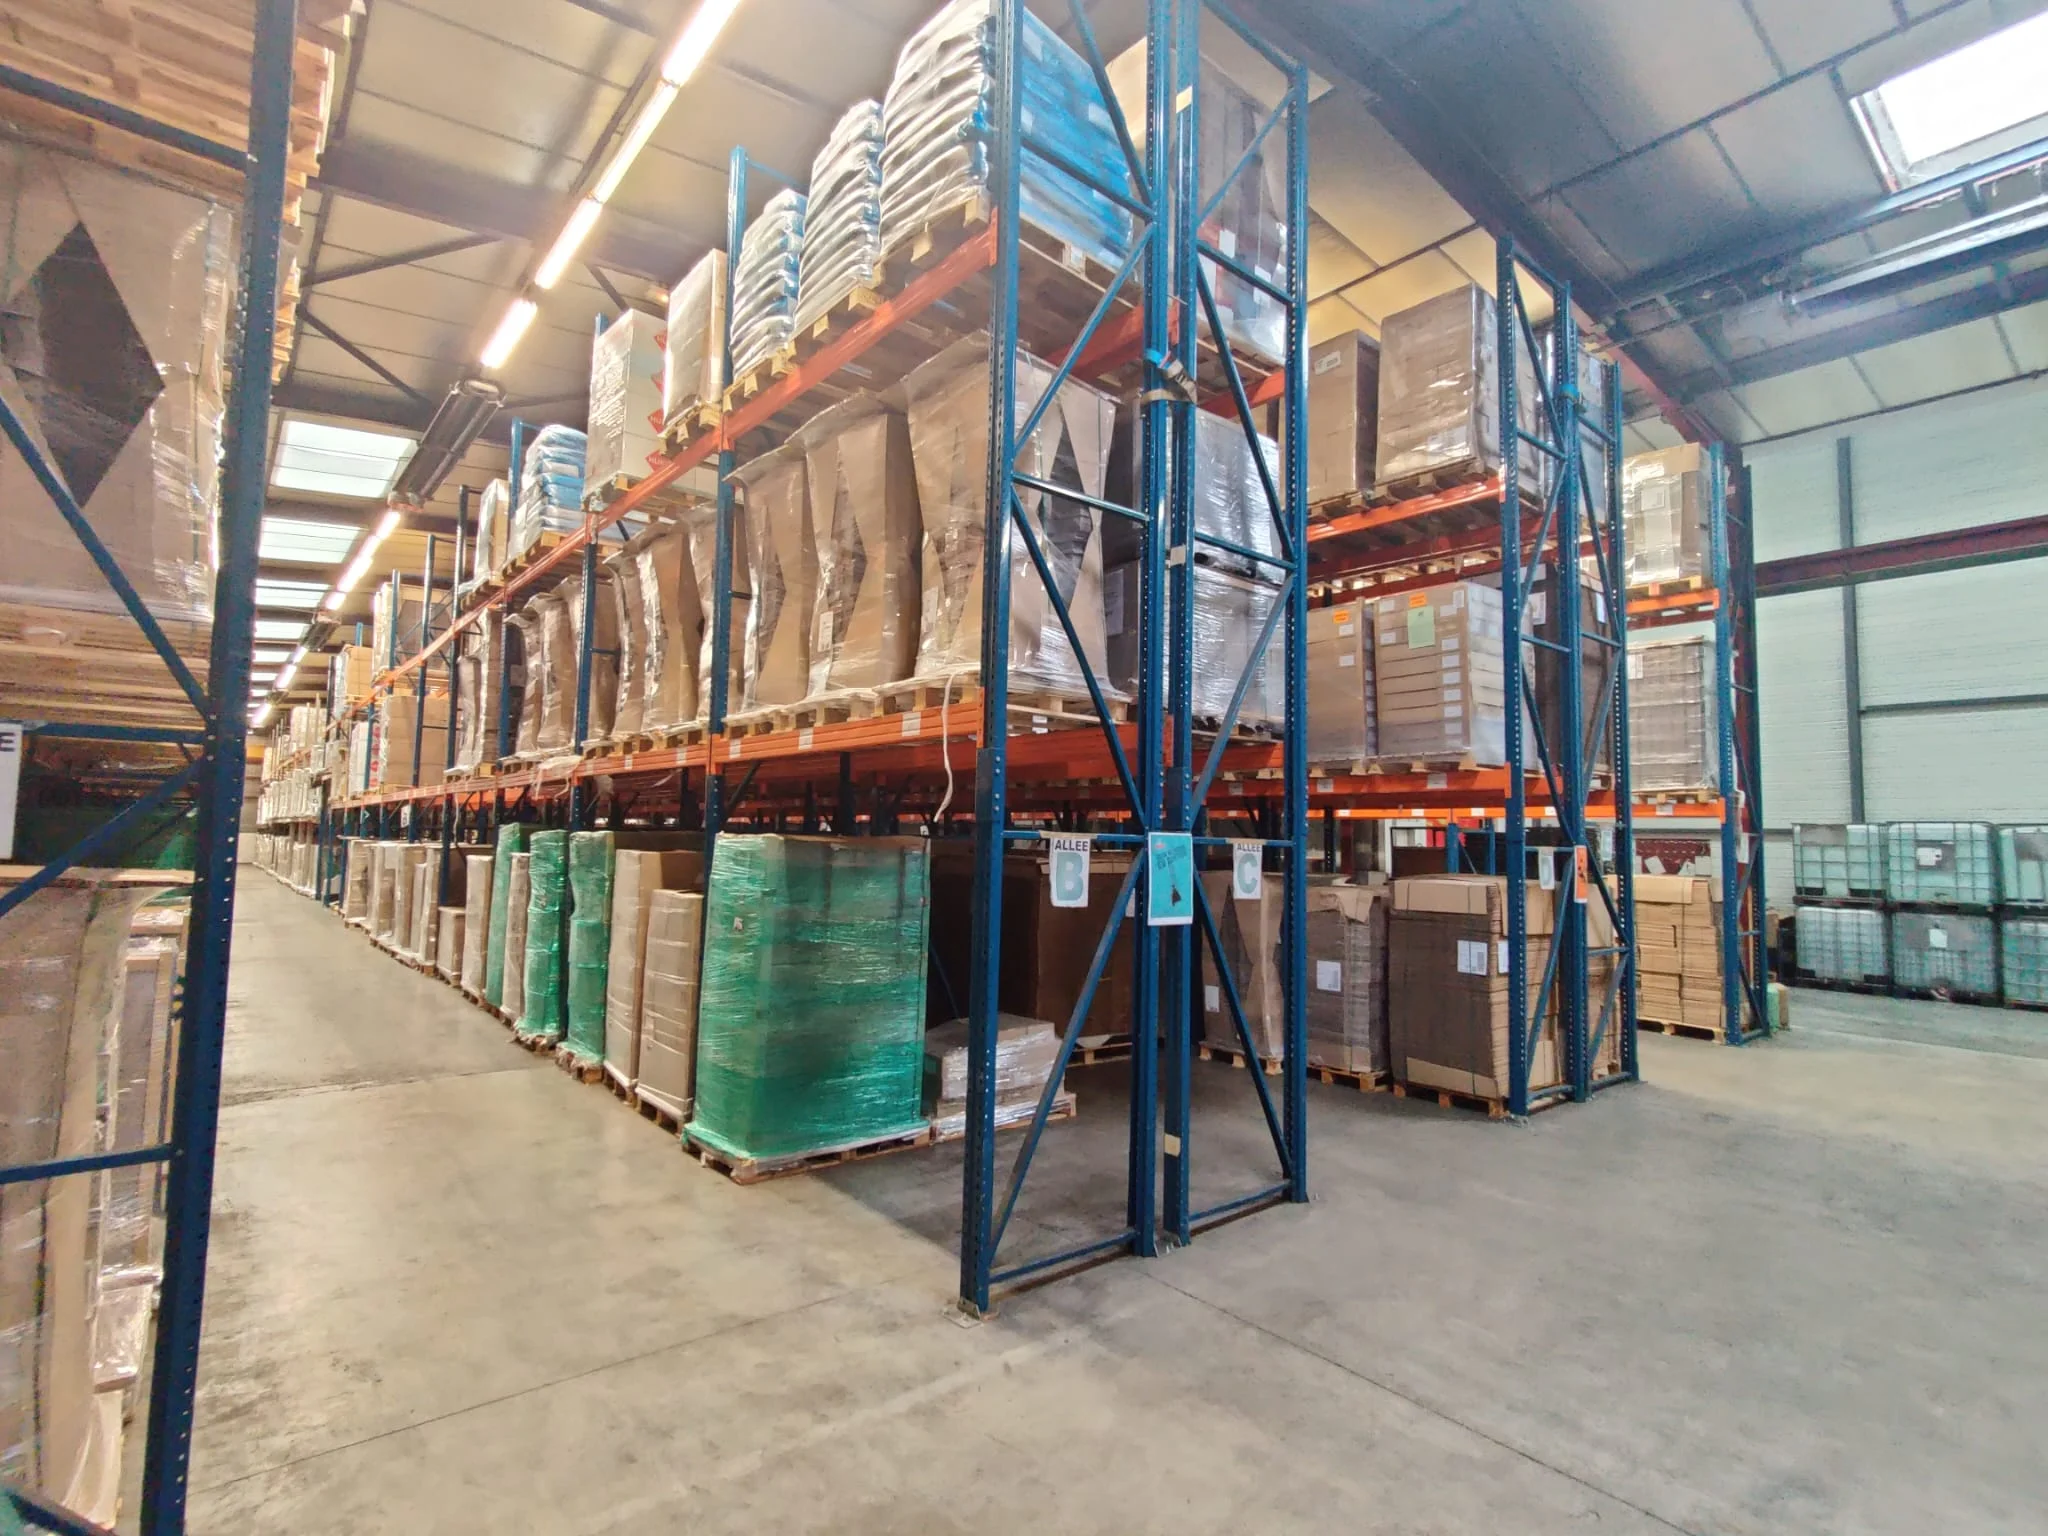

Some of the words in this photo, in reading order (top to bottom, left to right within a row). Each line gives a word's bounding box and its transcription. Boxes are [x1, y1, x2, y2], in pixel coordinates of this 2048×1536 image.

[1054, 840, 1089, 852] ALLEE
[1056, 851, 1084, 901] B
[1237, 853, 1258, 894] C
